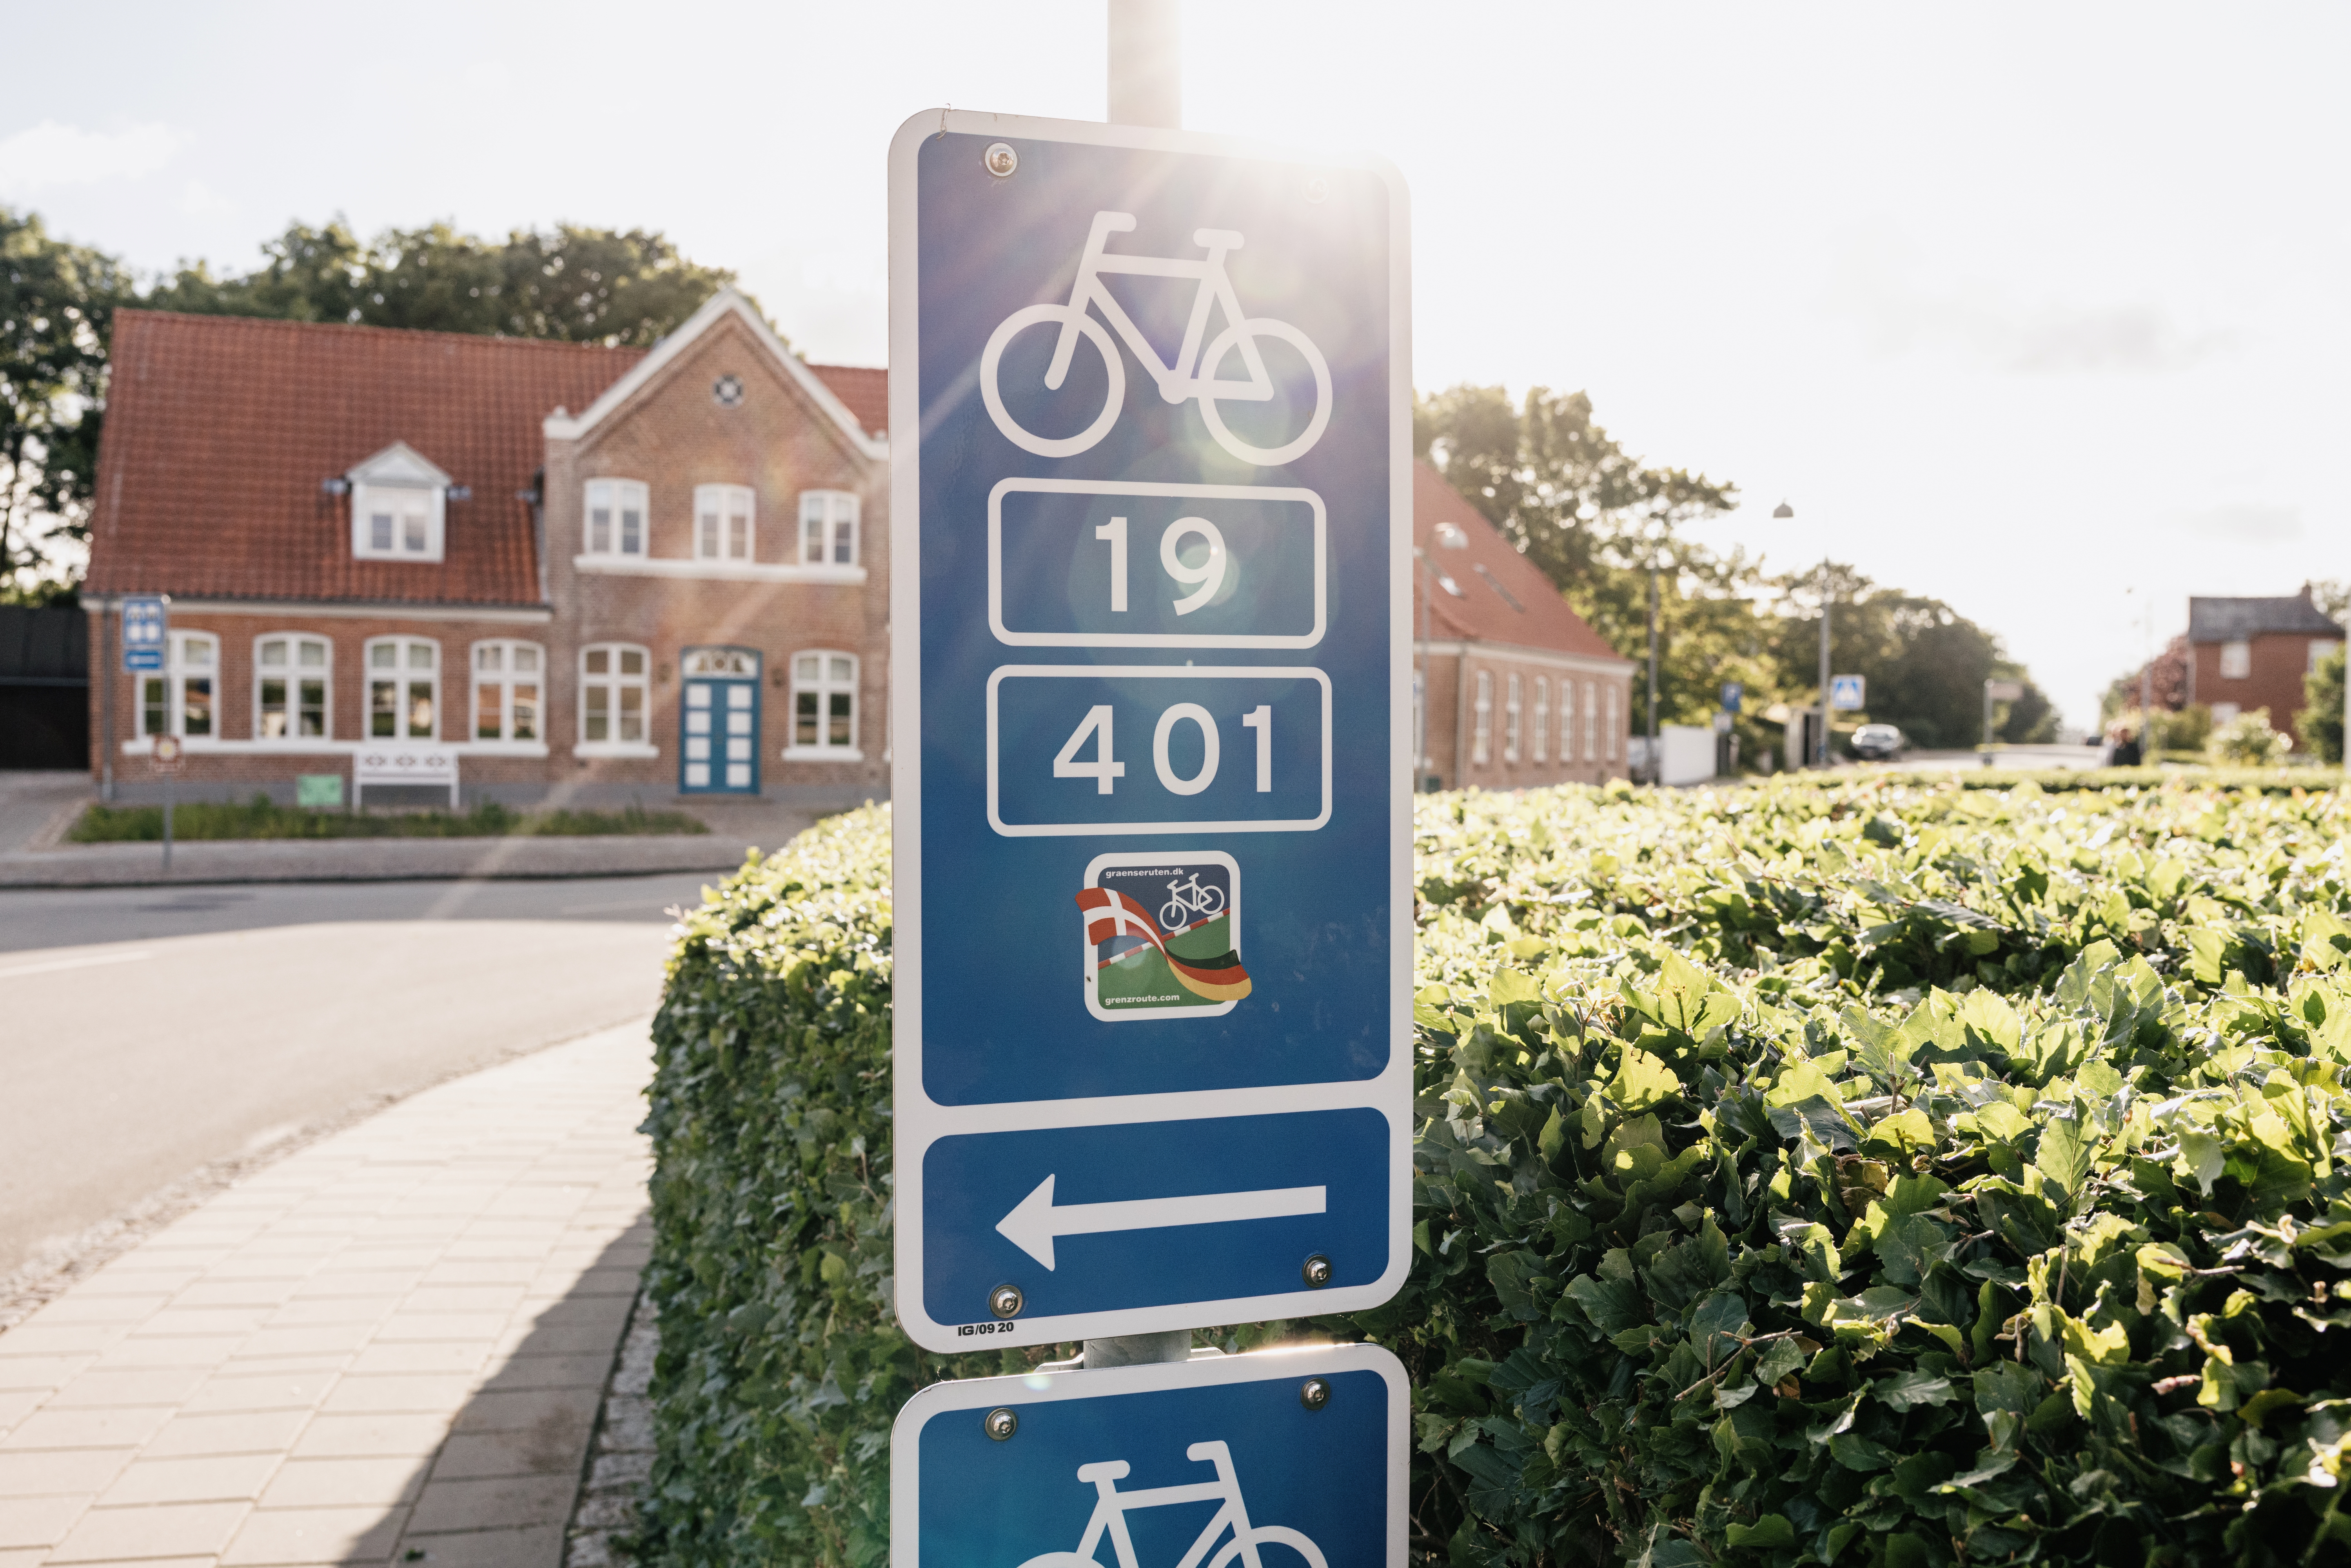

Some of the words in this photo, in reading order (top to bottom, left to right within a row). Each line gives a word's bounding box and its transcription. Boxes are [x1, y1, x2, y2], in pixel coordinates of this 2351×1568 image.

[1096, 517, 1227, 616] 19
[1053, 702, 1271, 795] 401
[1106, 868, 1184, 878] graenseruten.dk
[1105, 995, 1180, 1005] grenzroute.com
[958, 1324, 995, 1336] IG/09
[998, 1322, 1014, 1332] 20
